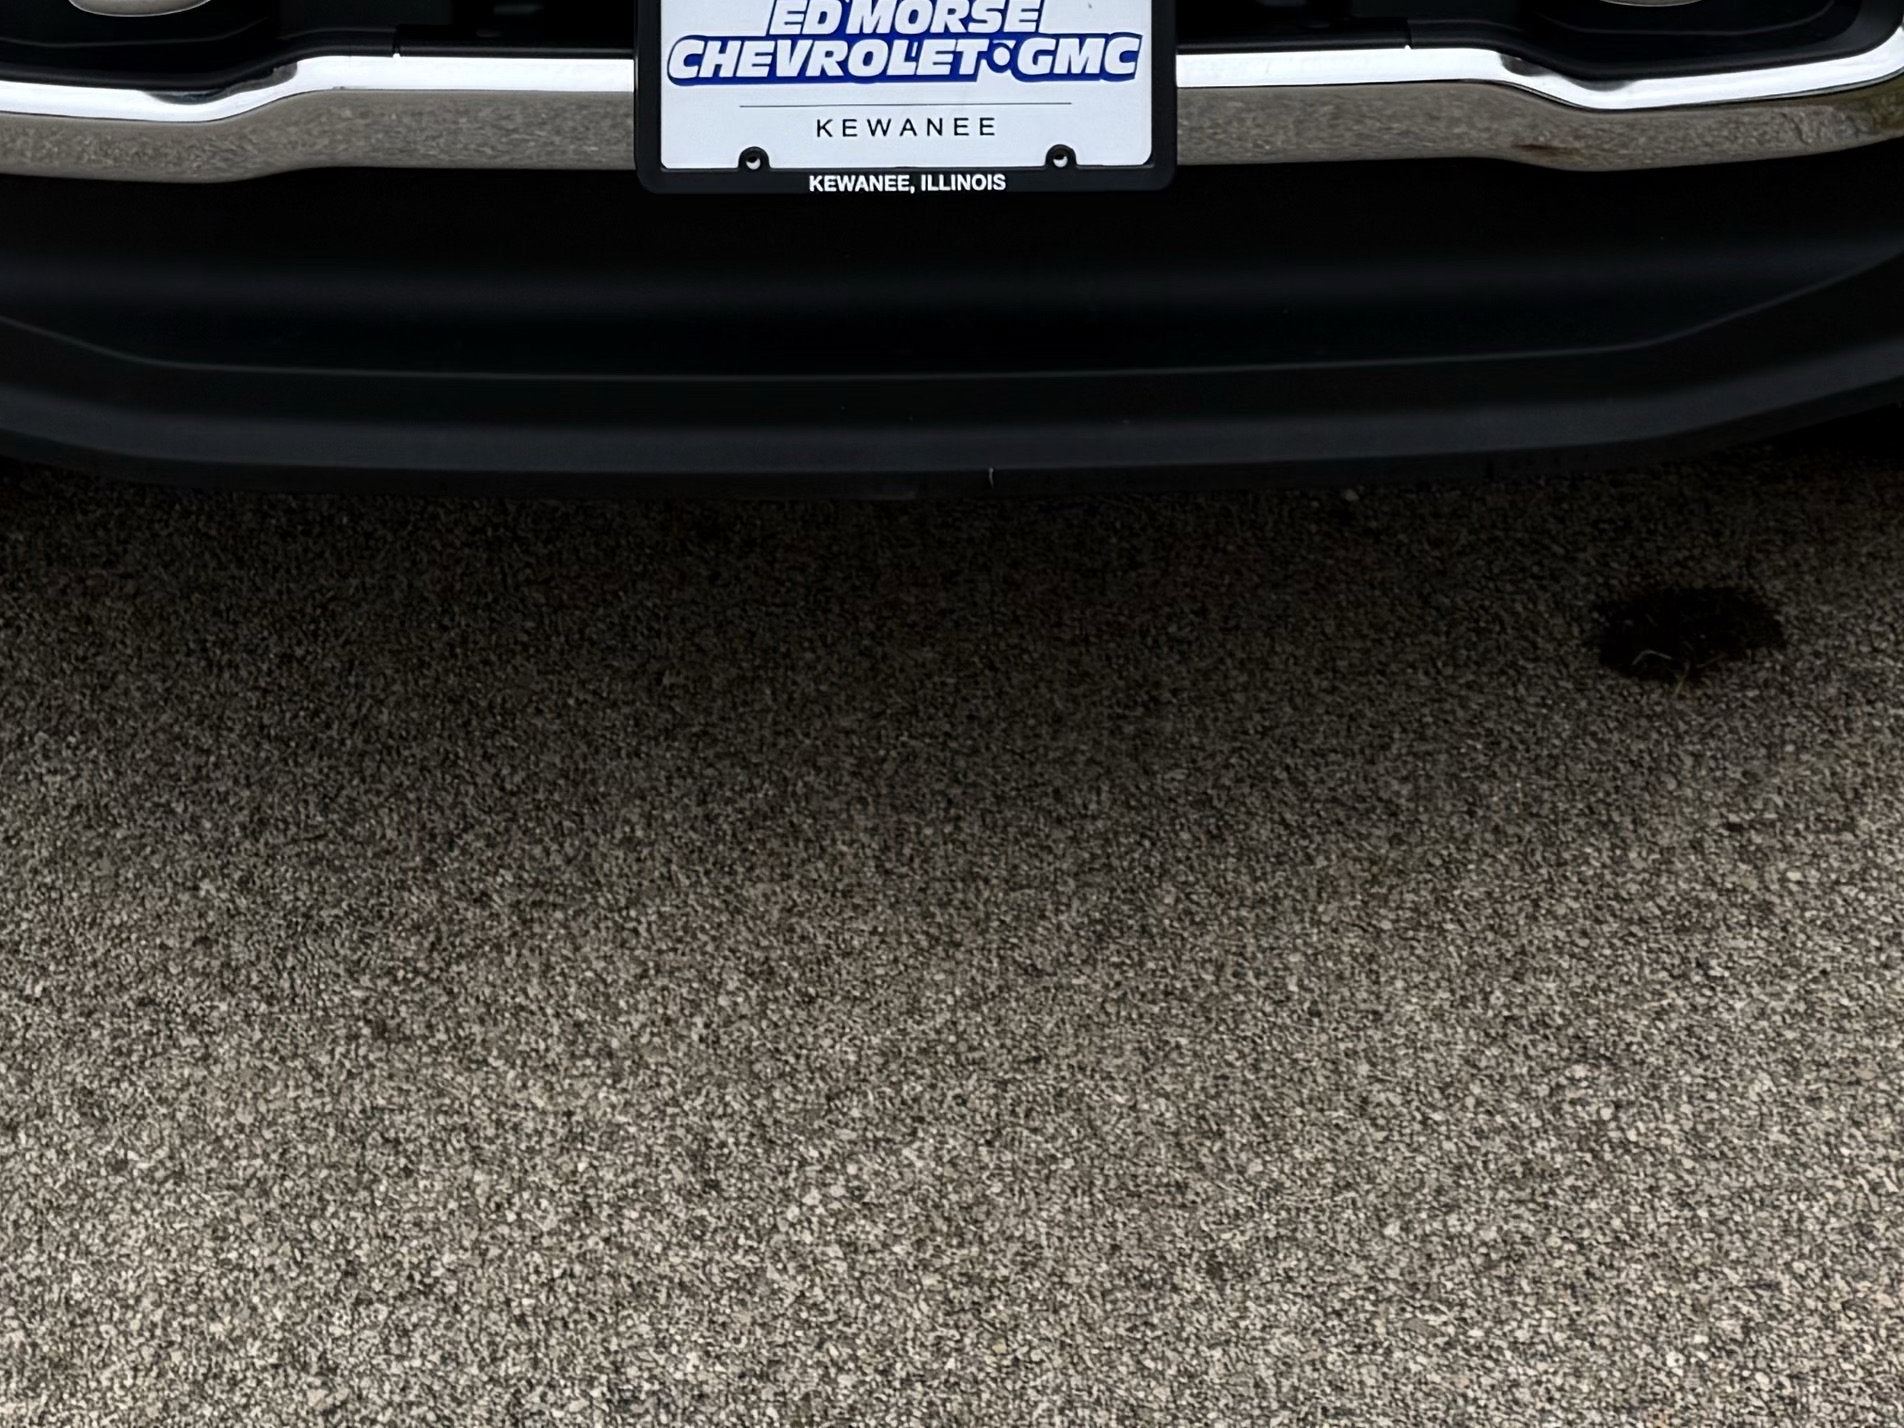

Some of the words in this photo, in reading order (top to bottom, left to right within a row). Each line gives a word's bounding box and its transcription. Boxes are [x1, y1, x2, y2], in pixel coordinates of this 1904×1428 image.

[816, 117, 996, 138] KEWANEE
[809, 174, 915, 194] KEWANEE,
[920, 174, 1007, 192] ILLINOIS
